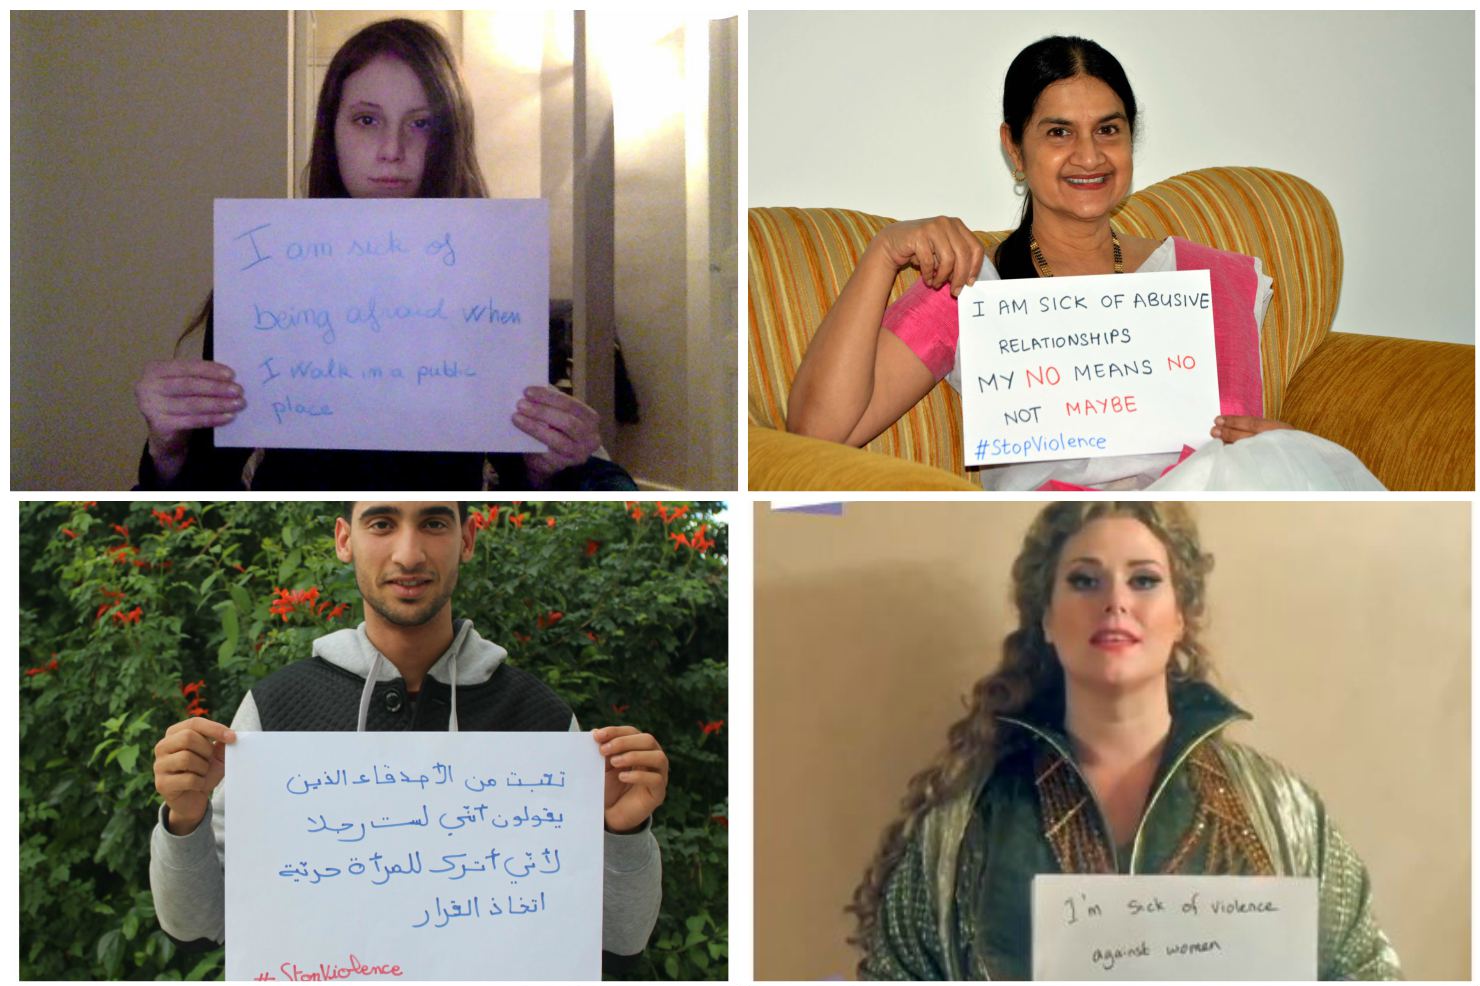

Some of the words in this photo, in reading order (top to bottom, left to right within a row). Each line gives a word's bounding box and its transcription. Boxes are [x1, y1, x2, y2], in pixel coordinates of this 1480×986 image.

[233, 223, 271, 271] I
[286, 239, 333, 259] am
[347, 231, 410, 257] sick
[426, 232, 456, 266] of
[972, 300, 985, 317] I
[999, 299, 1028, 315] AM
[1040, 295, 1088, 312] SICK
[1101, 294, 1125, 310] OF
[1134, 292, 1210, 309] ABUSIVE
[253, 302, 335, 344] being
[346, 299, 448, 331] afraid
[999, 328, 1132, 354] RELATIONSHIPS
[260, 357, 280, 385] I
[362, 368, 383, 378] in
[391, 368, 402, 378] a
[417, 361, 478, 385] public
[978, 371, 1015, 392] MY
[1026, 366, 1060, 388] NO
[1075, 360, 1153, 381] MEANS
[1168, 355, 1195, 371] NO
[272, 396, 334, 424] place
[1004, 407, 1042, 426] NOT
[1066, 396, 1137, 415] MAYBE
[975, 432, 1107, 460] #StopViolence
[286, 770, 347, 794] الذين
[464, 776, 497, 792] من
[507, 771, 565, 792] تعبت
[371, 804, 428, 828] لست
[492, 805, 563, 828] يقولون
[348, 851, 422, 885] للمرأة
[429, 848, 500, 880] أترك
[412, 897, 480, 927] القرار
[490, 892, 545, 915] اتخاذ
[1064, 893, 1102, 923] I'm
[1182, 892, 1200, 914] of
[1211, 900, 1280, 914] violence
[1092, 942, 1150, 970] against
[1166, 940, 1221, 956] women
